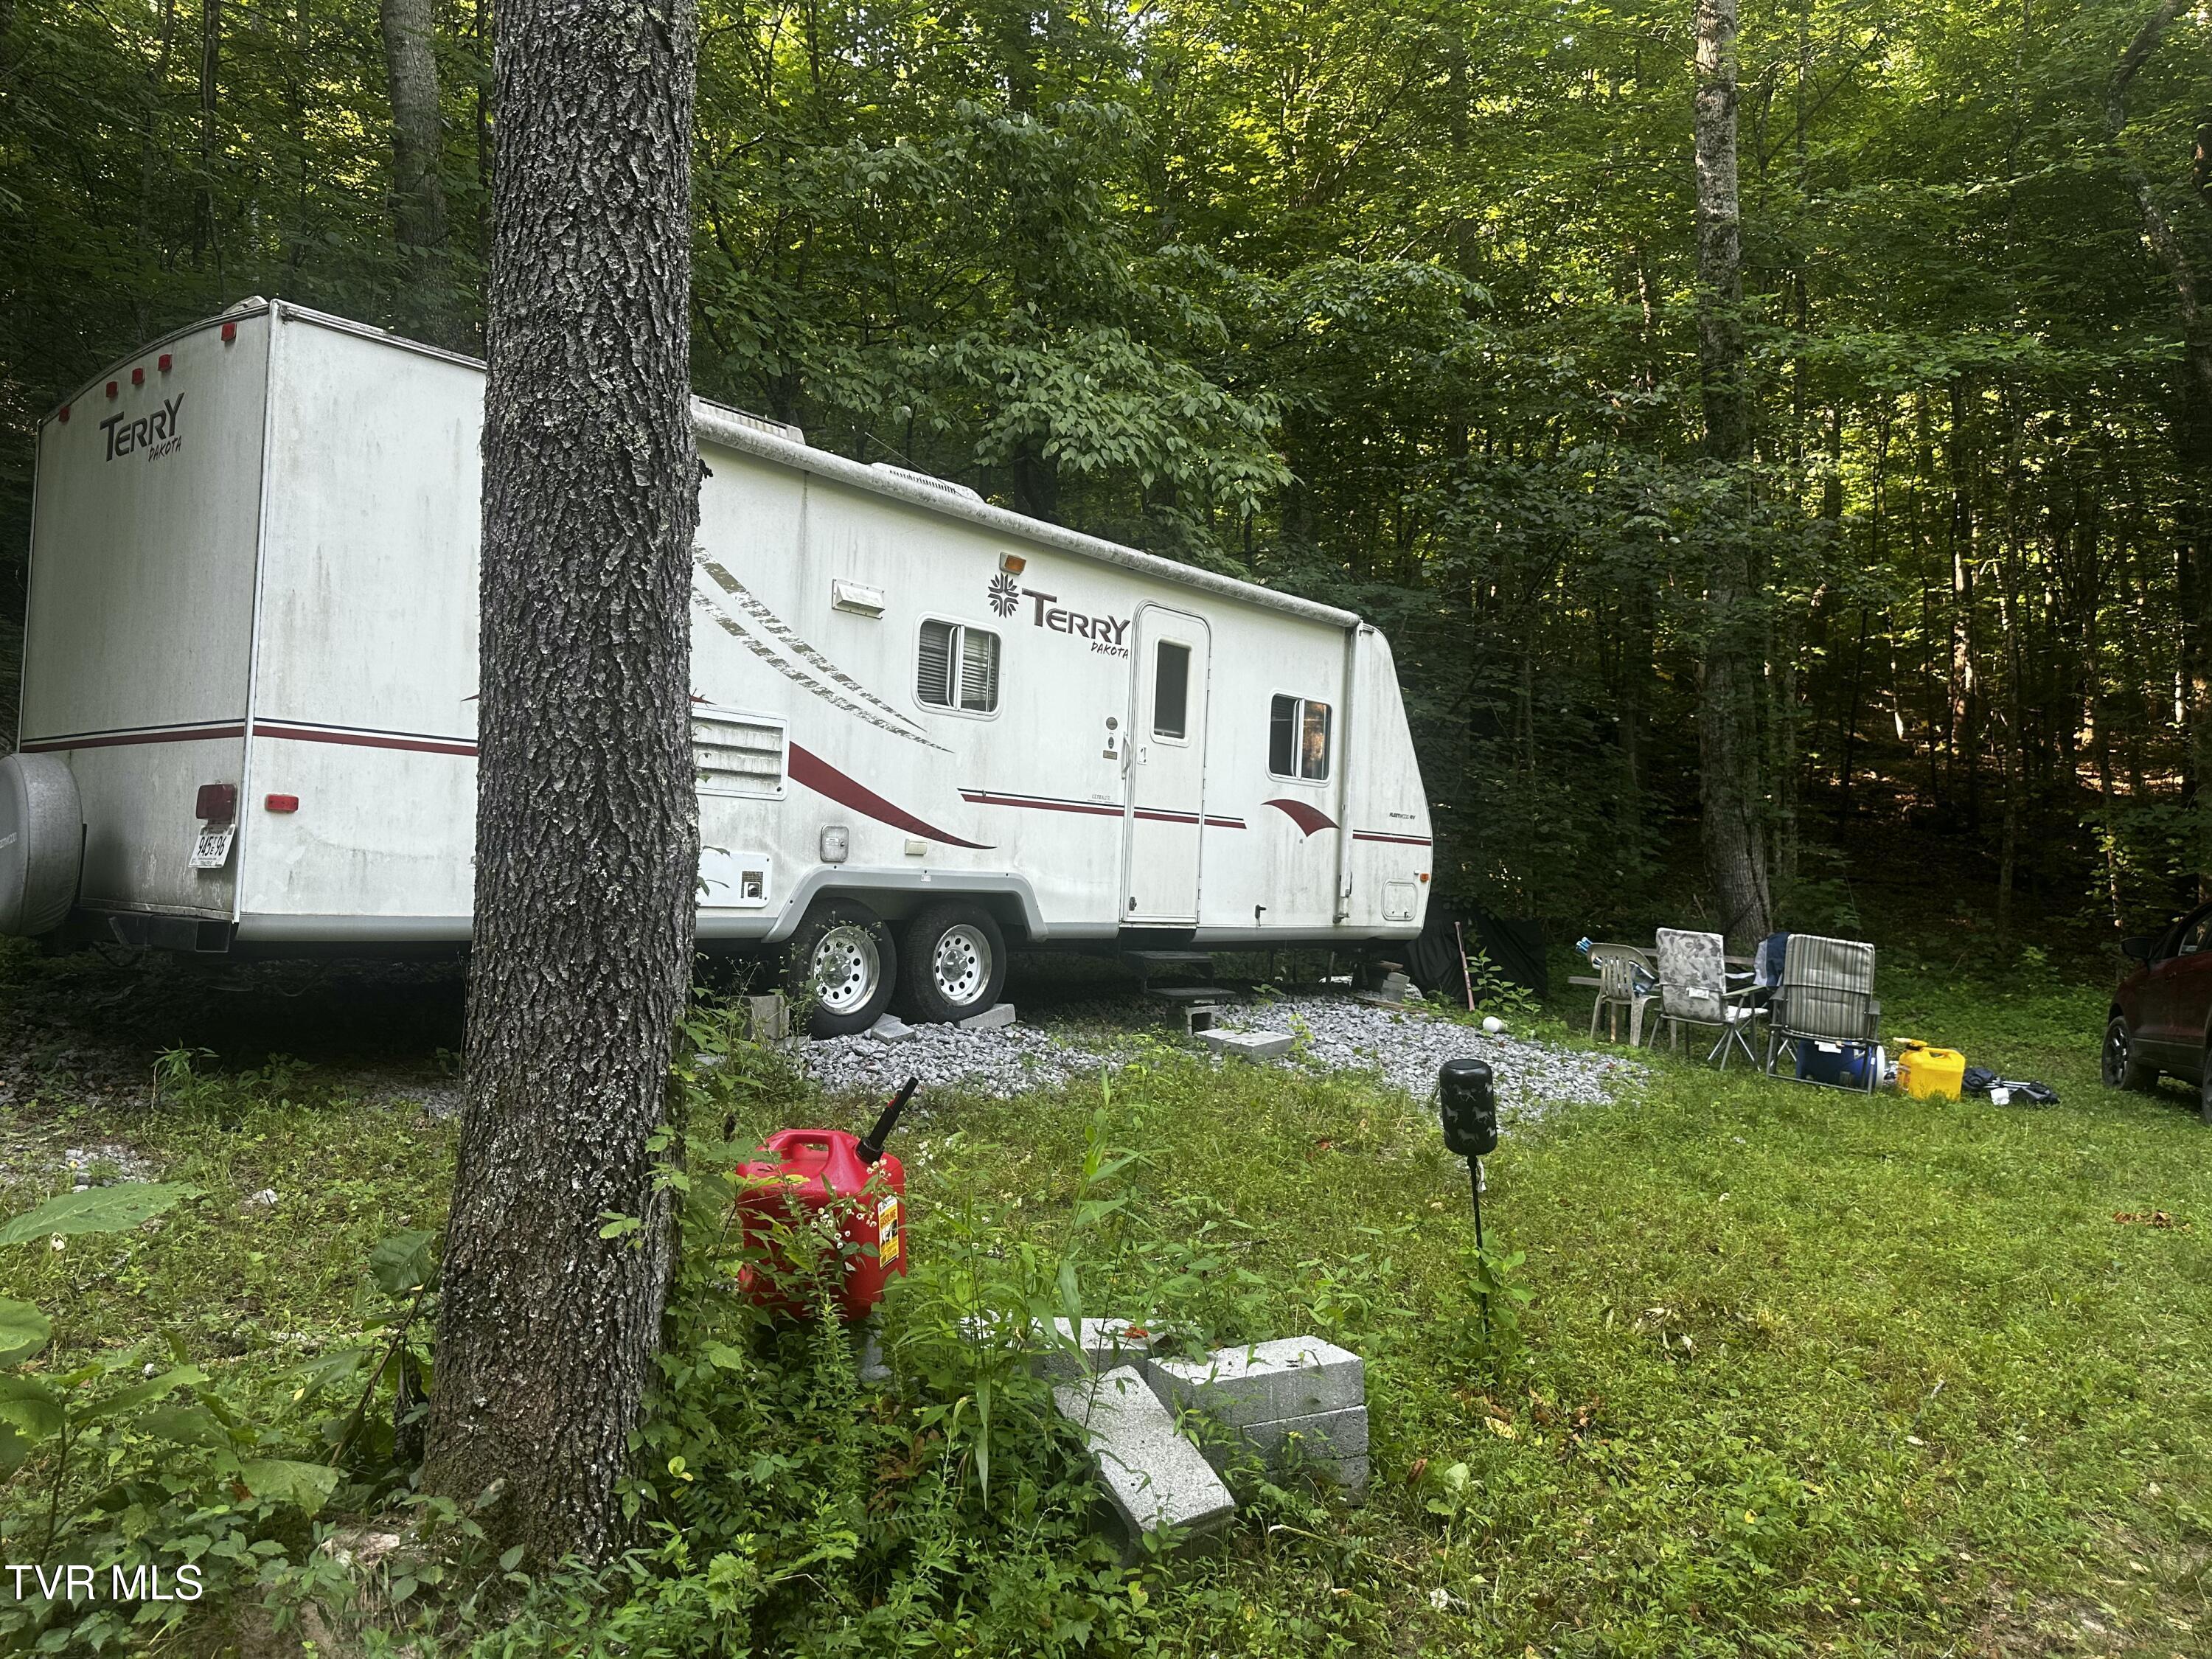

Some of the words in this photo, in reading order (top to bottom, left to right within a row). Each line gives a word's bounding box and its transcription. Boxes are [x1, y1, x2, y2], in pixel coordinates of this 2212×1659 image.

[100, 392, 185, 462] TERRY
[148, 435, 182, 463] DAKOTA
[1021, 588, 1130, 645] TERRY
[1091, 641, 1129, 659] DAKOTA
